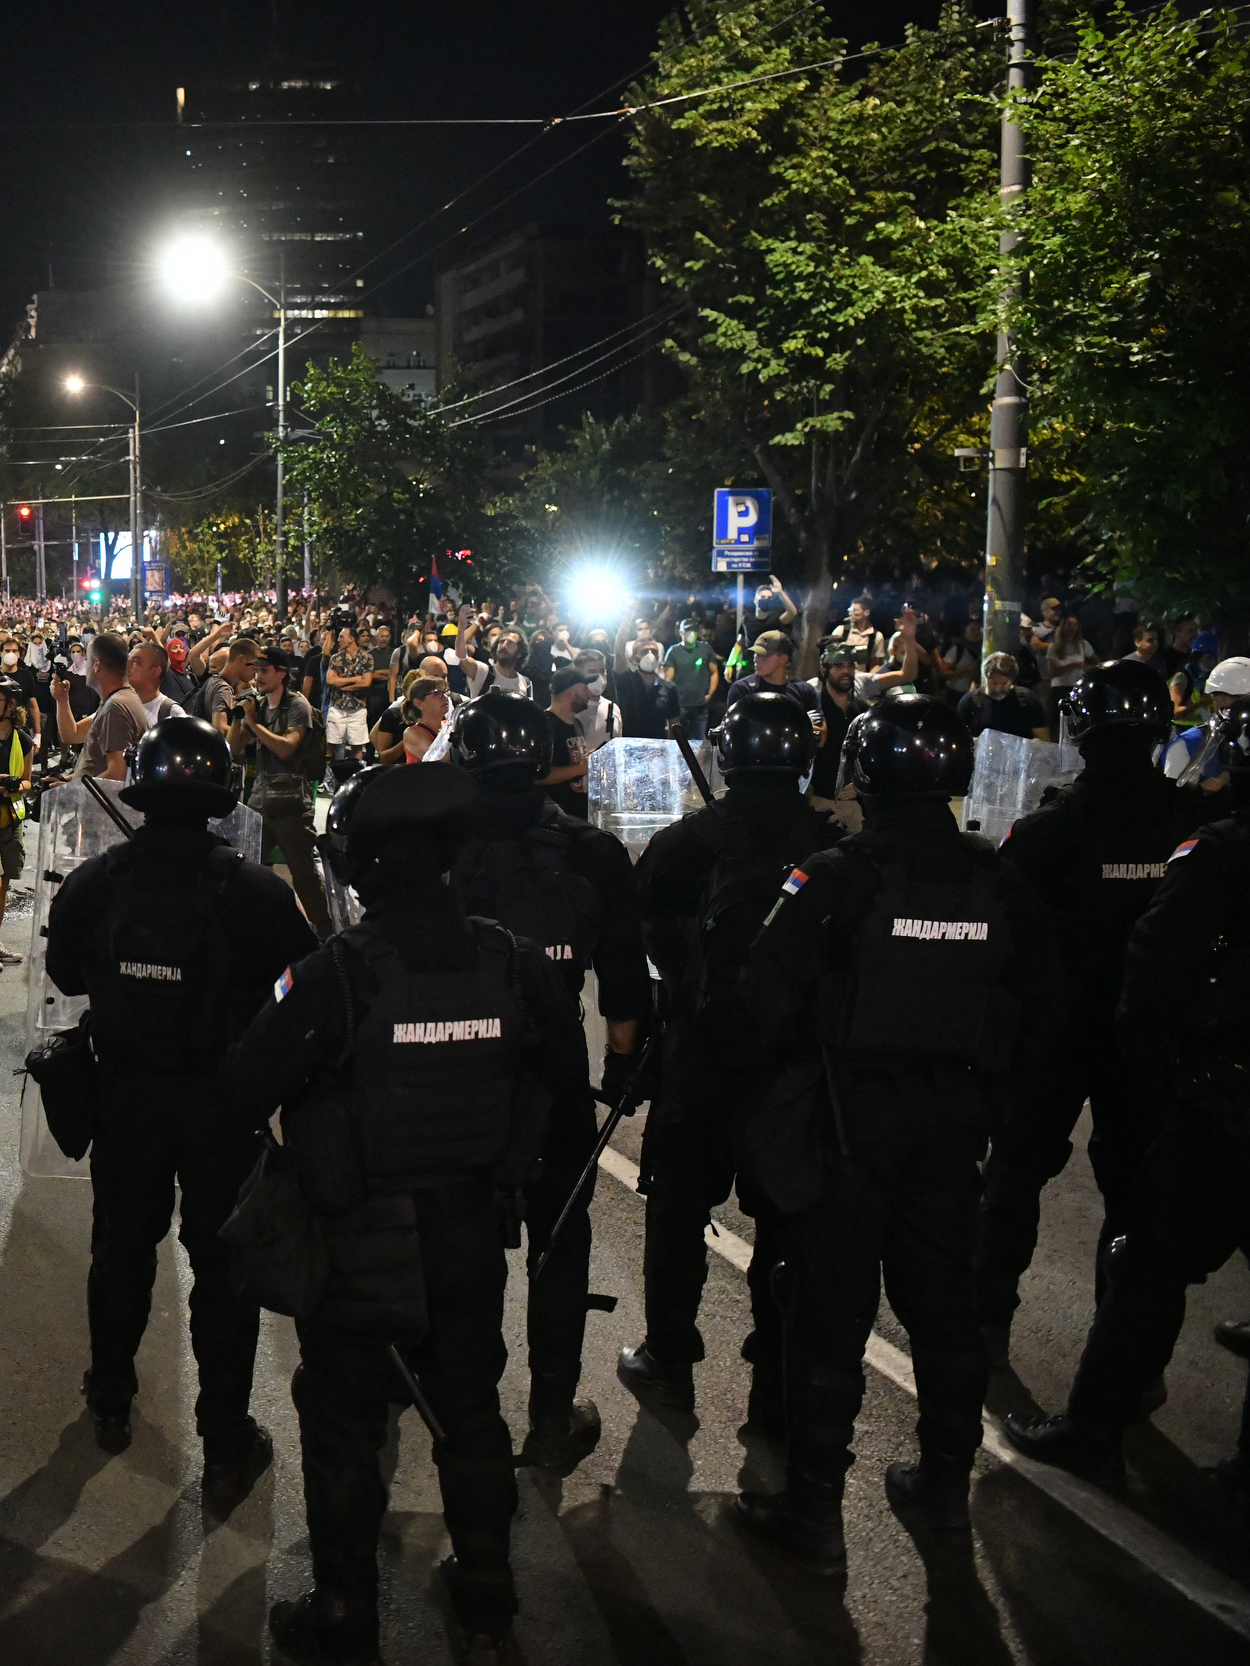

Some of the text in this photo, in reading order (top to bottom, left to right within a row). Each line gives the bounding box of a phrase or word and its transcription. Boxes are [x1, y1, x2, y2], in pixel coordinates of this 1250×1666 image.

[728, 496, 759, 539] P
[1102, 863, 1168, 879] ЖАНДАРМЕ
[892, 918, 988, 940] ЖАНДАРМЕРИЈА
[119, 961, 182, 981] ЖАНДАРМЕРИЈА
[393, 1018, 501, 1044] ЖАНДАРМЕРИЈА
